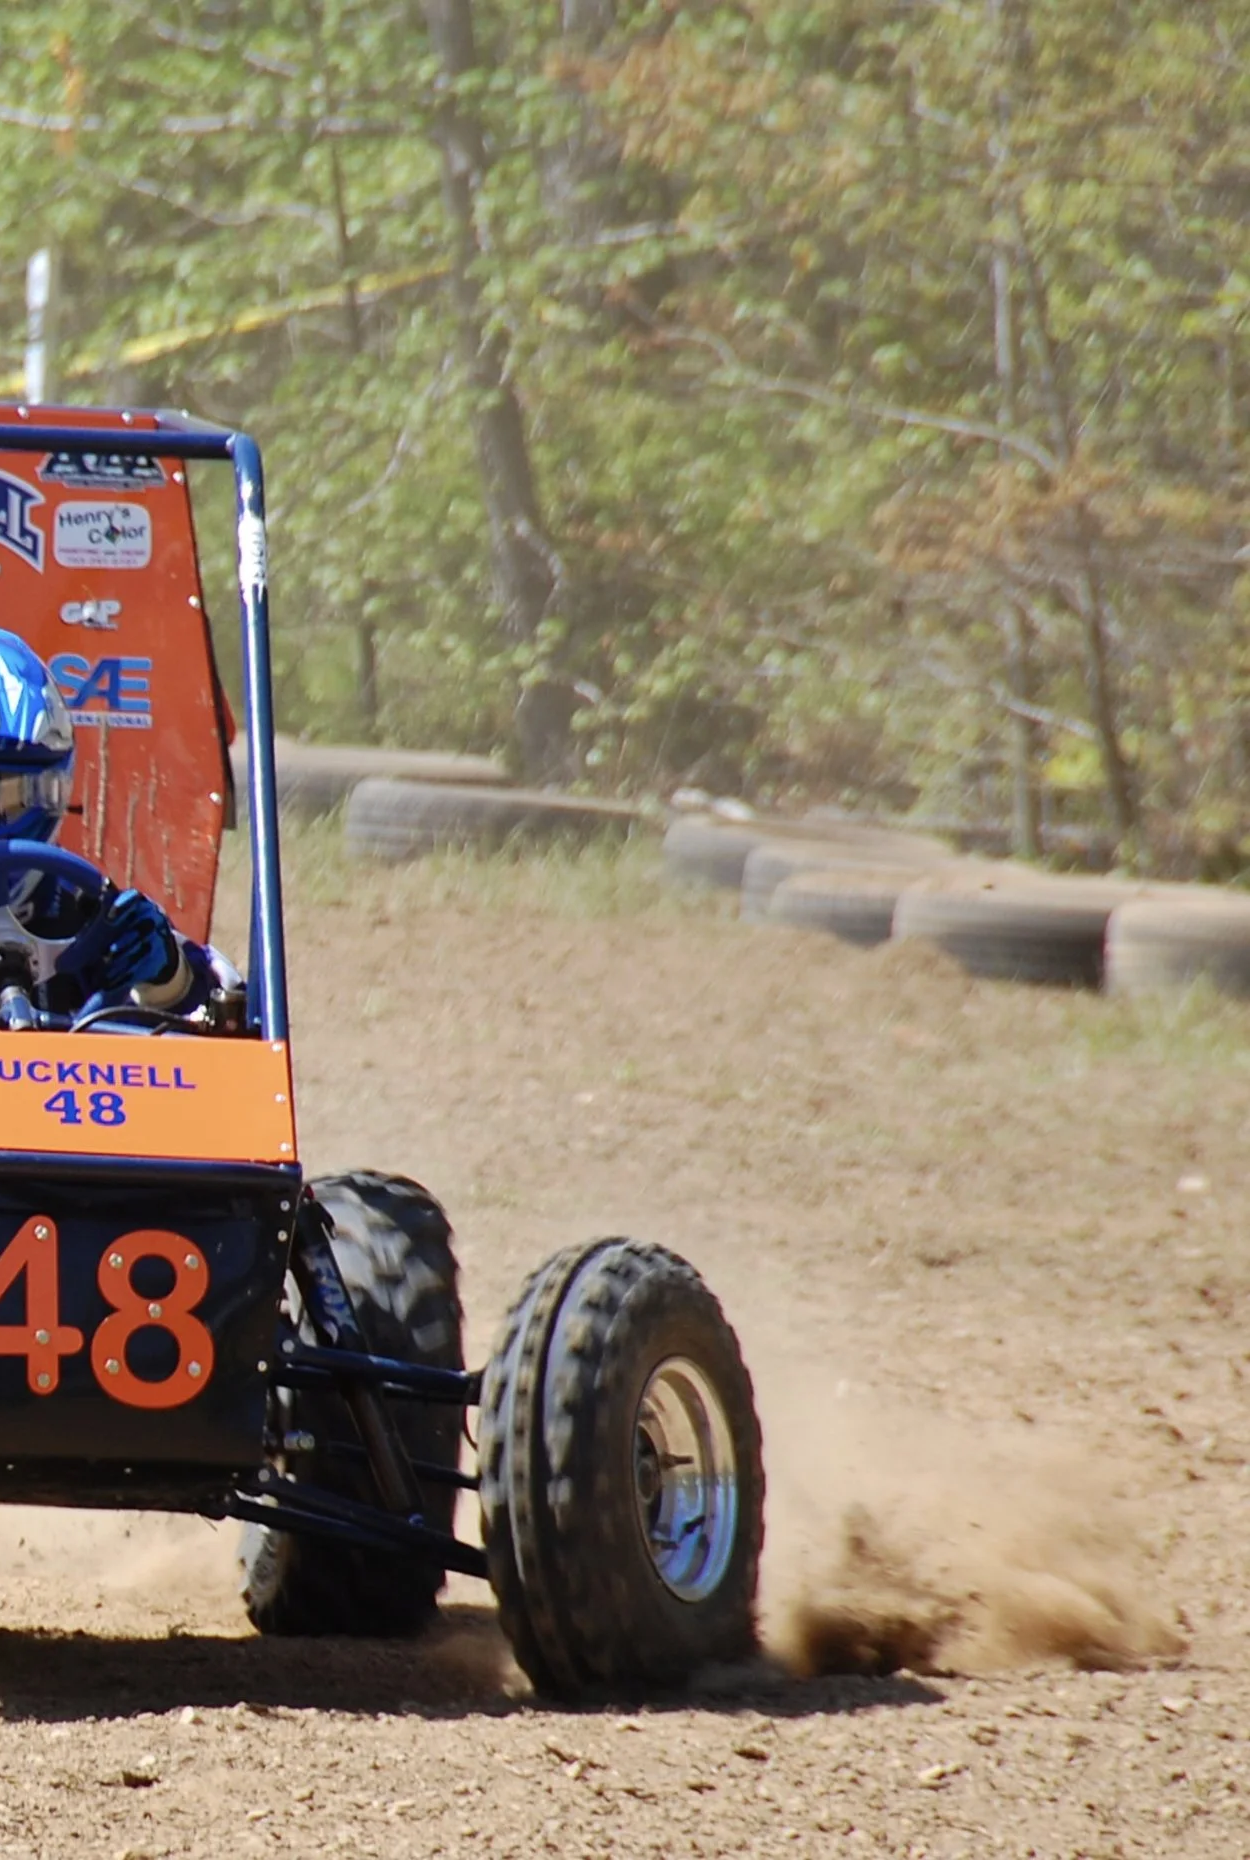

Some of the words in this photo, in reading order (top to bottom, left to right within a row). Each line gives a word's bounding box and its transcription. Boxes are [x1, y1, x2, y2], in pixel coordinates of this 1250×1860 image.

[58, 505, 131, 529] Henry's
[49, 653, 152, 711] SAE
[43, 1090, 127, 1126] 48
